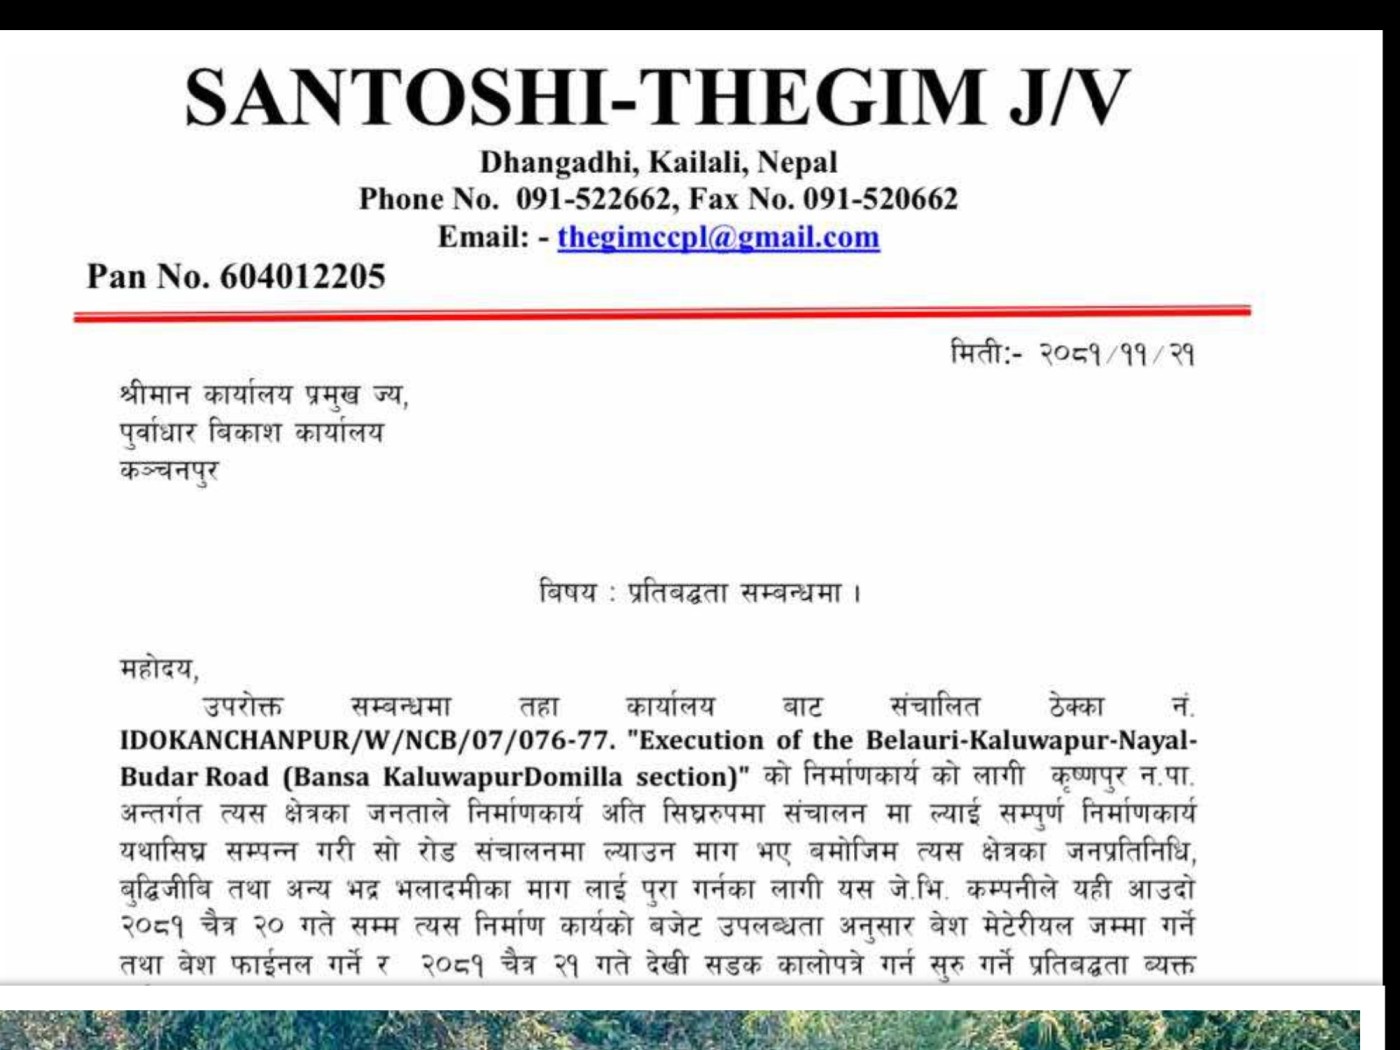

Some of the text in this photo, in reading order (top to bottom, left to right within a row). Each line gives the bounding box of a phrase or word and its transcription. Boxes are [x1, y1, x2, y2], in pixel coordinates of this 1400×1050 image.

[186, 67, 1132, 127] SANTOSHI-THEGIM J/V
[480, 149, 838, 181] Dhangadhi, Kailali, Nepal
[359, 186, 958, 214] Phone No. 091-522662, Fax No. 091-520662
[438, 224, 529, 248] Email:
[556, 224, 882, 255] thegimccpl@gmail.com
[87, 262, 386, 290] Pan No. 604012205
[120, 377, 192, 405] श्रीमान
[203, 377, 294, 405] कार्यालय
[304, 385, 362, 413] प्रमुख
[294, 415, 386, 443] कार्यालय
[739, 583, 843, 603] सम्बन्धमा
[119, 652, 199, 684] महोदय,
[202, 690, 285, 718] उपरोक्त
[350, 697, 453, 717] सम्बन्धमा
[518, 697, 561, 717] तहा
[625, 689, 717, 717] कार्यालय
[782, 697, 825, 718] बाट
[889, 689, 982, 717] संचालित
[1048, 690, 1106, 718] ठेक्का
[120, 728, 1198, 756] IDOKANCHANPUR/W/NCB/07/076-77. "Execution of the Belauri-Kaluwapur-Nayal-
[120, 765, 199, 787] Budar
[205, 765, 269, 787] Road
[283, 765, 370, 793] (Bansa
[383, 765, 623, 793] KaluwapurDomilla
[636, 765, 750, 793] section)"
[762, 759, 792, 785] को
[803, 758, 921, 786] निर्माणकार्य
[931, 759, 961, 786] को
[972, 758, 1026, 786] लागी
[227, 879, 271, 900] तथा
[287, 879, 332, 900] अन्य
[347, 880, 381, 900] भद्र
[395, 872, 512, 900] भलादमीका
[526, 880, 571, 900] माग
[584, 872, 628, 901] लाई
[641, 880, 678, 908] पुरा
[692, 872, 756, 900] गर्नका
[770, 872, 824, 900] लागी
[837, 880, 875, 900] यस
[966, 872, 1059, 900] कम्पनीले
[1073, 872, 1113, 900] यही
[1128, 873, 1197, 901] आउदो
[121, 915, 183, 939] २०८१
[200, 907, 238, 936] चैत्र
[253, 915, 284, 938] २०
[299, 909, 336, 936] गते
[350, 916, 400, 936] सम्म
[413, 916, 462, 936] त्यस
[474, 909, 546, 937] निर्माण
[559, 908, 635, 937] कार्यको
[648, 910, 703, 938] बजेट
[717, 916, 824, 938] उपलब्धता
[840, 916, 916, 945] अनुसार
[982, 909, 1075, 938] मेटेरीयल
[1088, 916, 1147, 936] जम्मा
[1160, 908, 1196, 936] गर्ने
[119, 955, 164, 975] तथा
[230, 947, 314, 977] फाईनल
[327, 948, 363, 975] गर्ने
[376, 955, 390, 971] र
[421, 954, 483, 979] २०८१
[500, 946, 537, 975] चैत्र
[554, 954, 578, 979] २१
[595, 949, 632, 975] गते
[646, 948, 690, 975] देखी
[704, 955, 763, 977] सडक
[777, 948, 865, 975] कालोपत्रे
[879, 947, 916, 975] गर्न
[929, 955, 965, 982] सुरु
[978, 947, 1015, 975] गर्ने
[1143, 955, 1198, 975] व्यक्त
